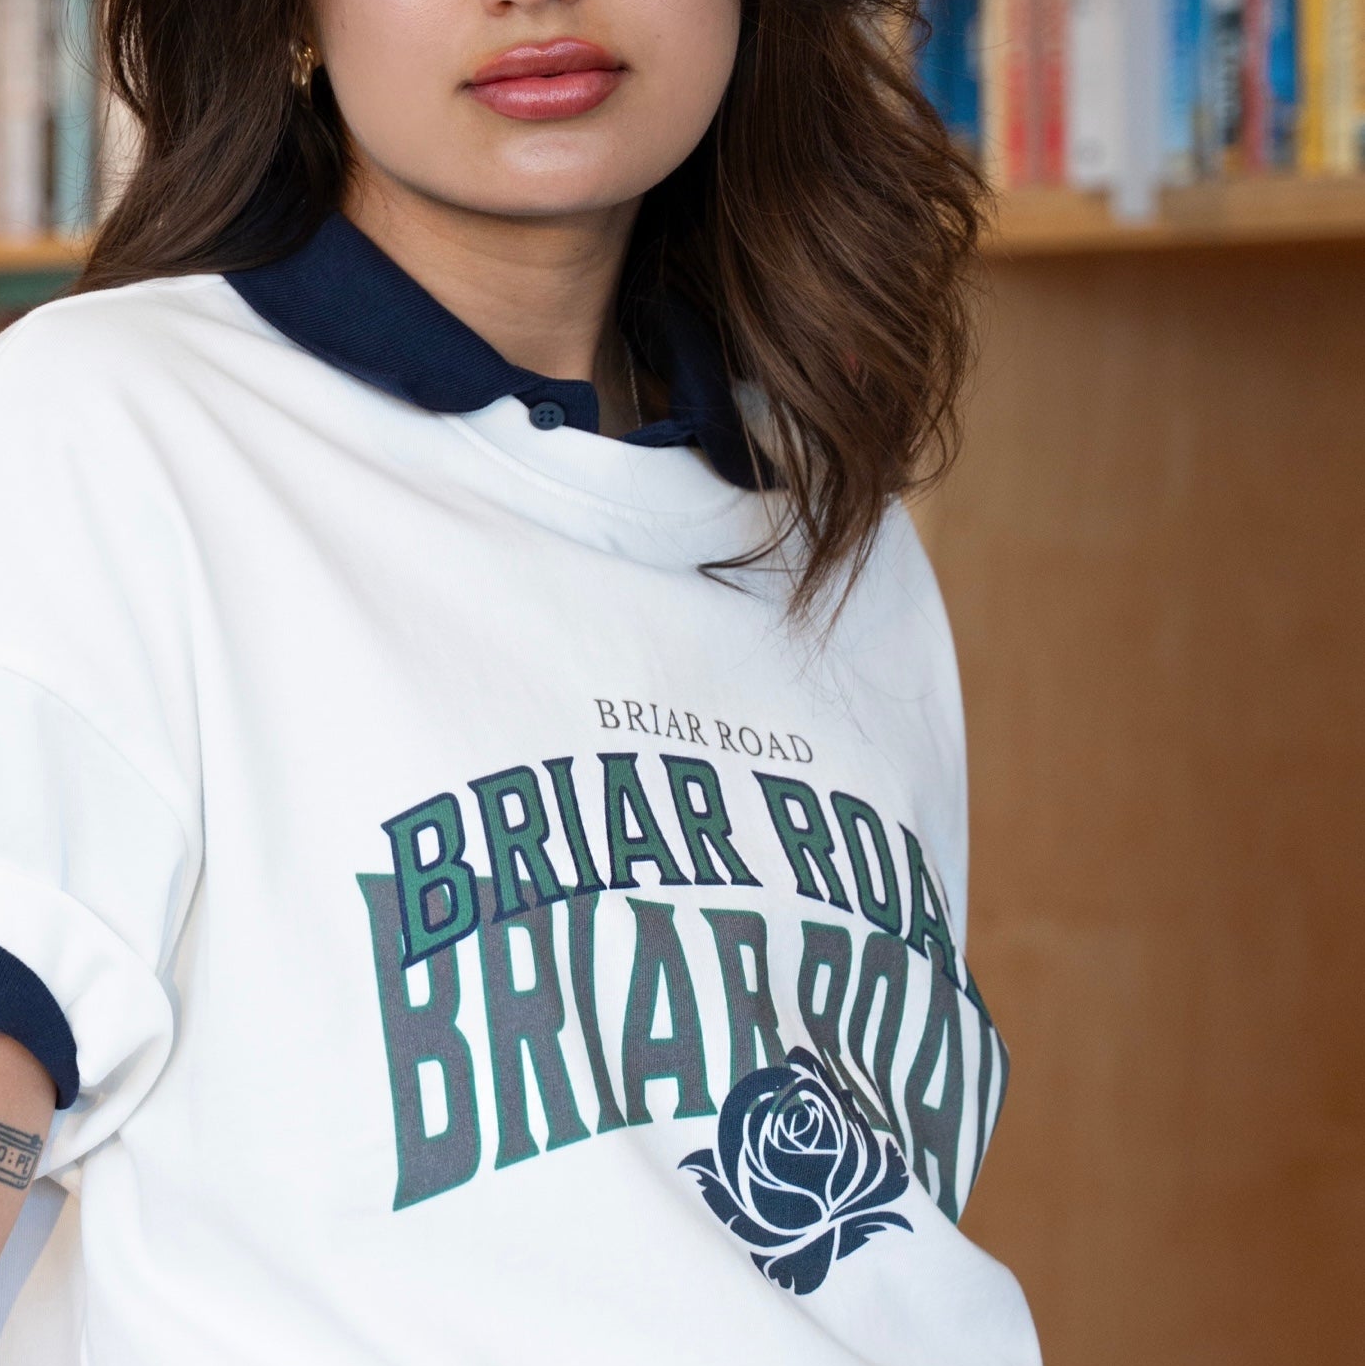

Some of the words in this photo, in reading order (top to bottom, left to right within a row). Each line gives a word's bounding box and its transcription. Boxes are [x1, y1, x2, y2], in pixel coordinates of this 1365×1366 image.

[594, 698, 709, 747] BRIAR
[714, 719, 814, 764] ROAD
[380, 751, 763, 970] BRIAR
[355, 872, 797, 1212] BRIAR
